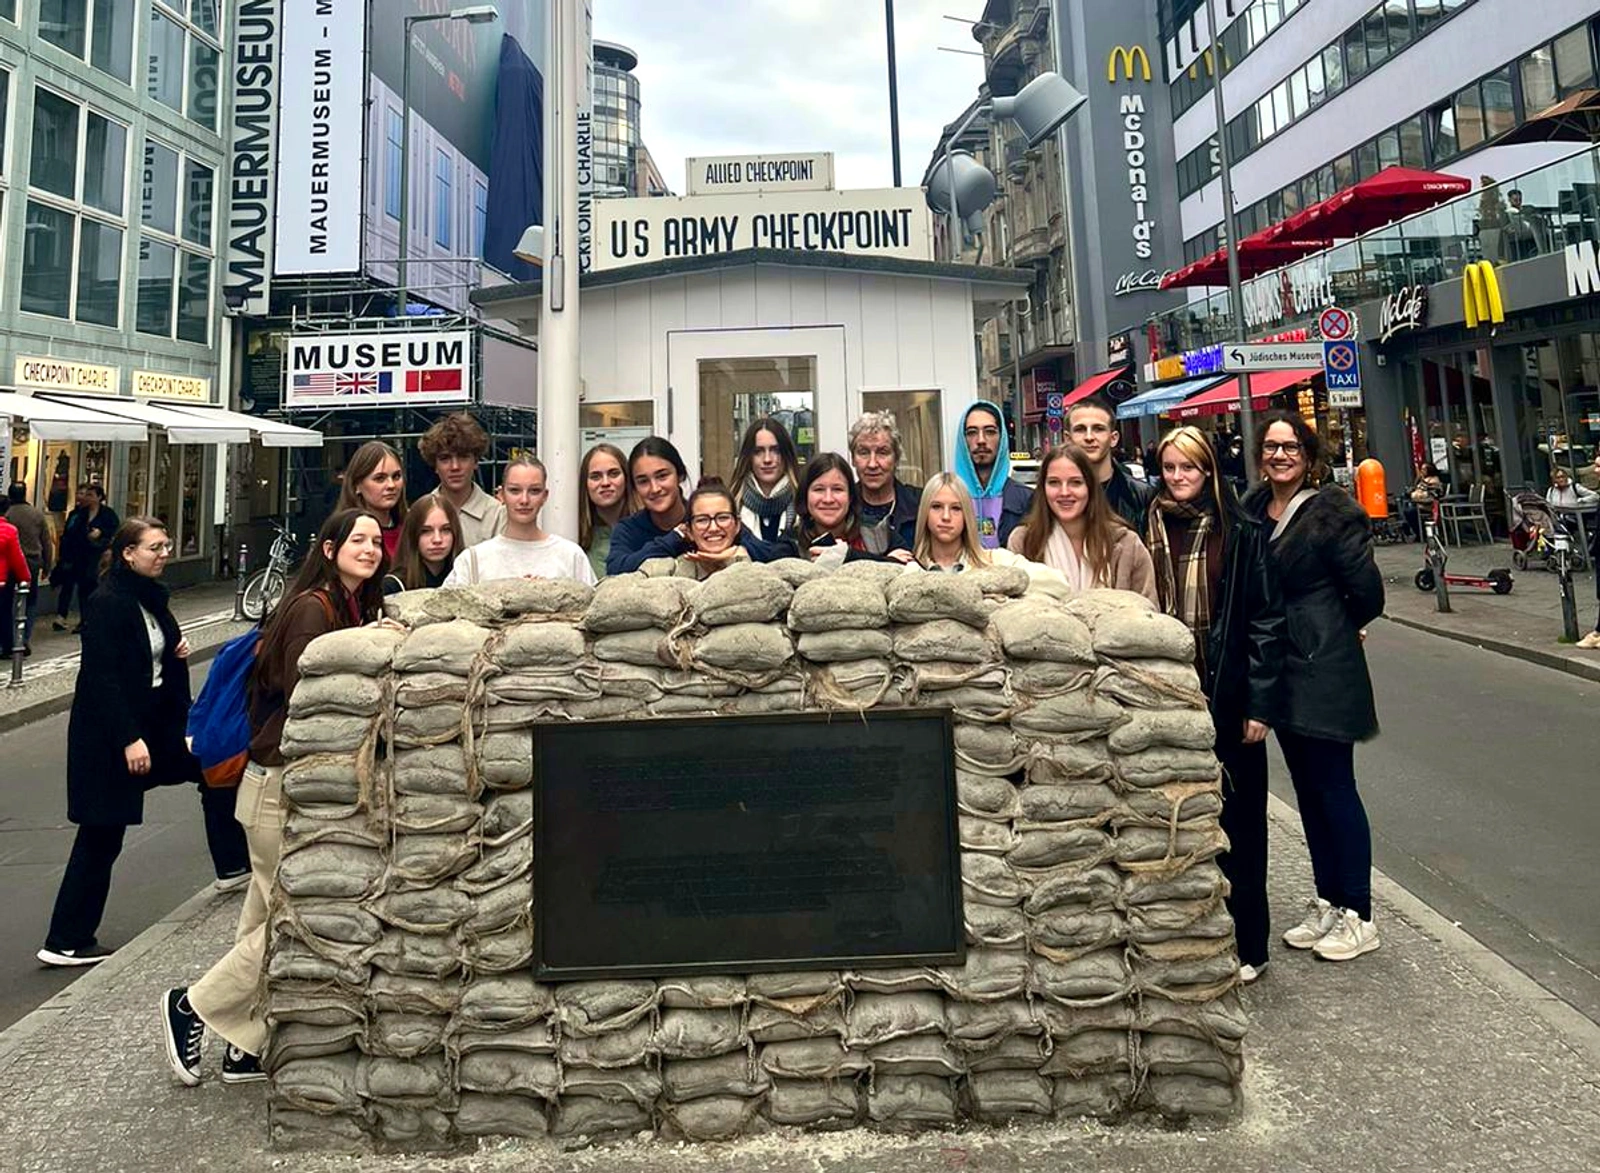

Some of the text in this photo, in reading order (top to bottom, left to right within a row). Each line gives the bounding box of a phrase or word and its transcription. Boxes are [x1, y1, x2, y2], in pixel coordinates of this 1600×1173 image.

[309, 49, 332, 254] MAUERMUSEUM
[578, 112, 591, 186] CHARLIE
[705, 159, 815, 184] ALLIED CHECKPOINT
[1119, 94, 1155, 259] McDonald's
[610, 208, 913, 259] US ARMY CHECKPOINT
[1114, 268, 1170, 293] McCaf
[1565, 239, 1600, 298] M
[1379, 284, 1423, 334] McCafé
[294, 340, 463, 370] MUSEUM
[1249, 351, 1322, 361] Jüdisches Museum
[23, 362, 108, 388] CHECKPOINT CHARLIE
[138, 374, 202, 397] CHECKPOINT CHARLIE
[1329, 373, 1357, 385] TAXI
